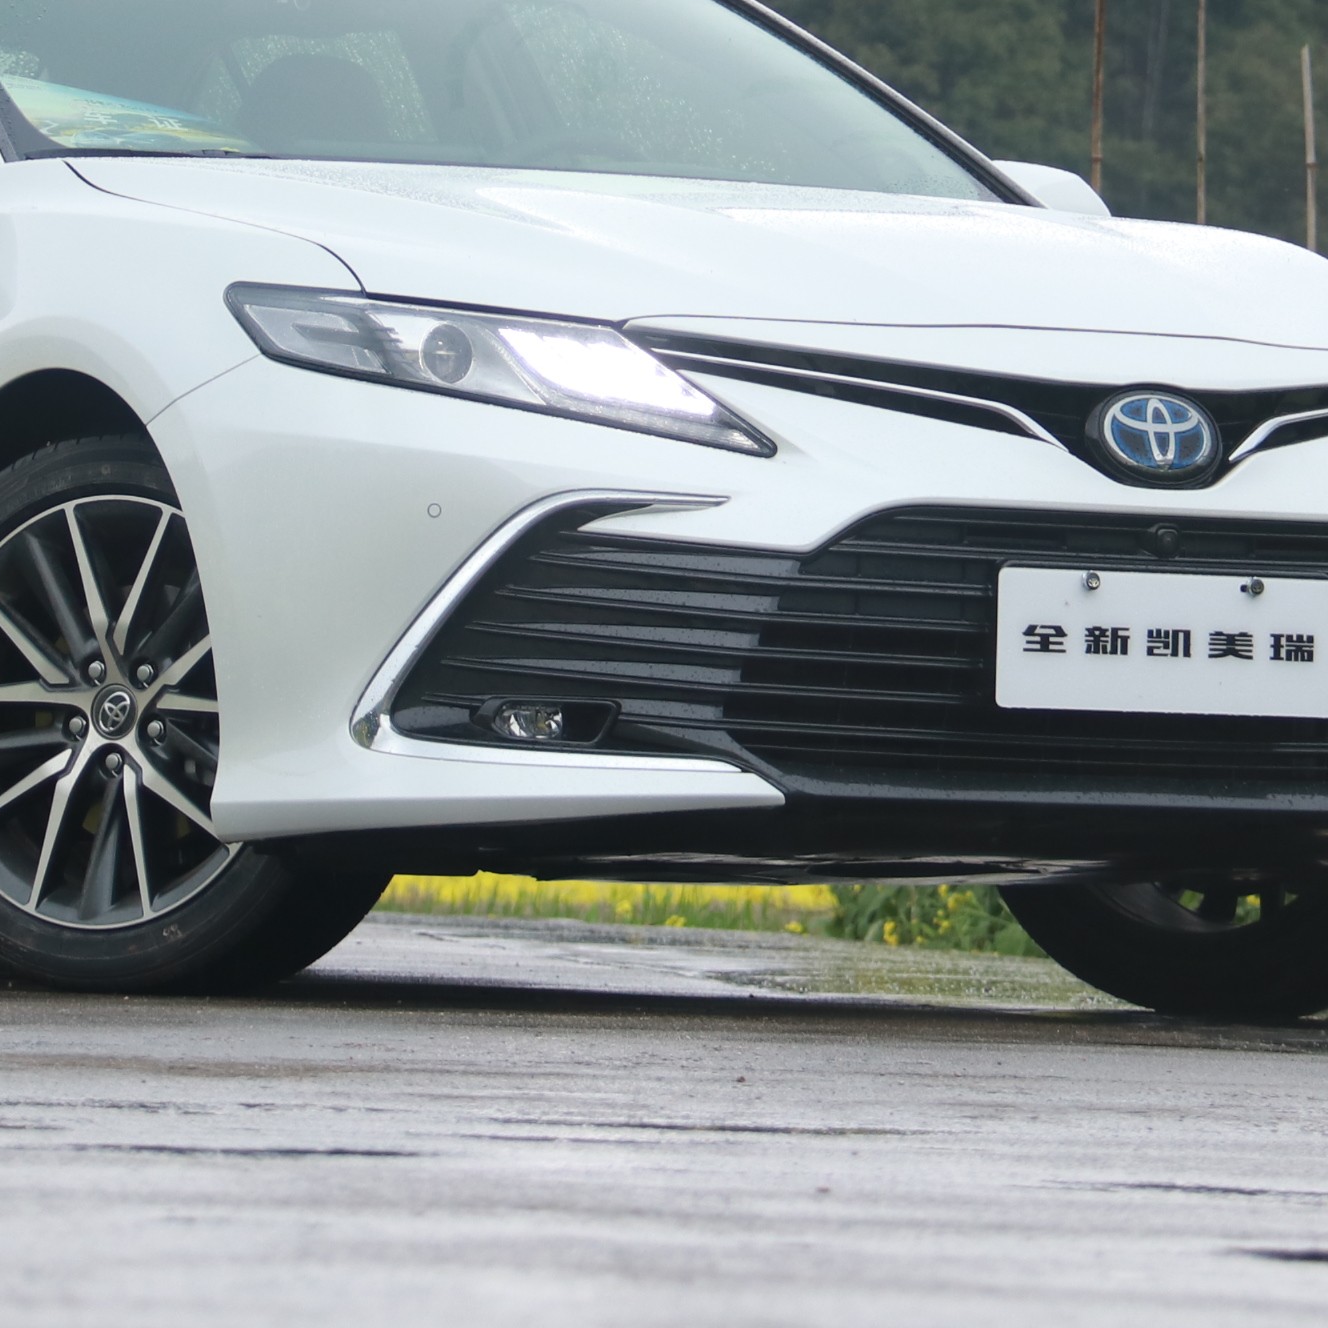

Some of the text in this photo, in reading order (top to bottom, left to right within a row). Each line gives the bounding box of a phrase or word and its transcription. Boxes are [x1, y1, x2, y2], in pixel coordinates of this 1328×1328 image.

[1022, 624, 1315, 663] 全新凯美瑞
